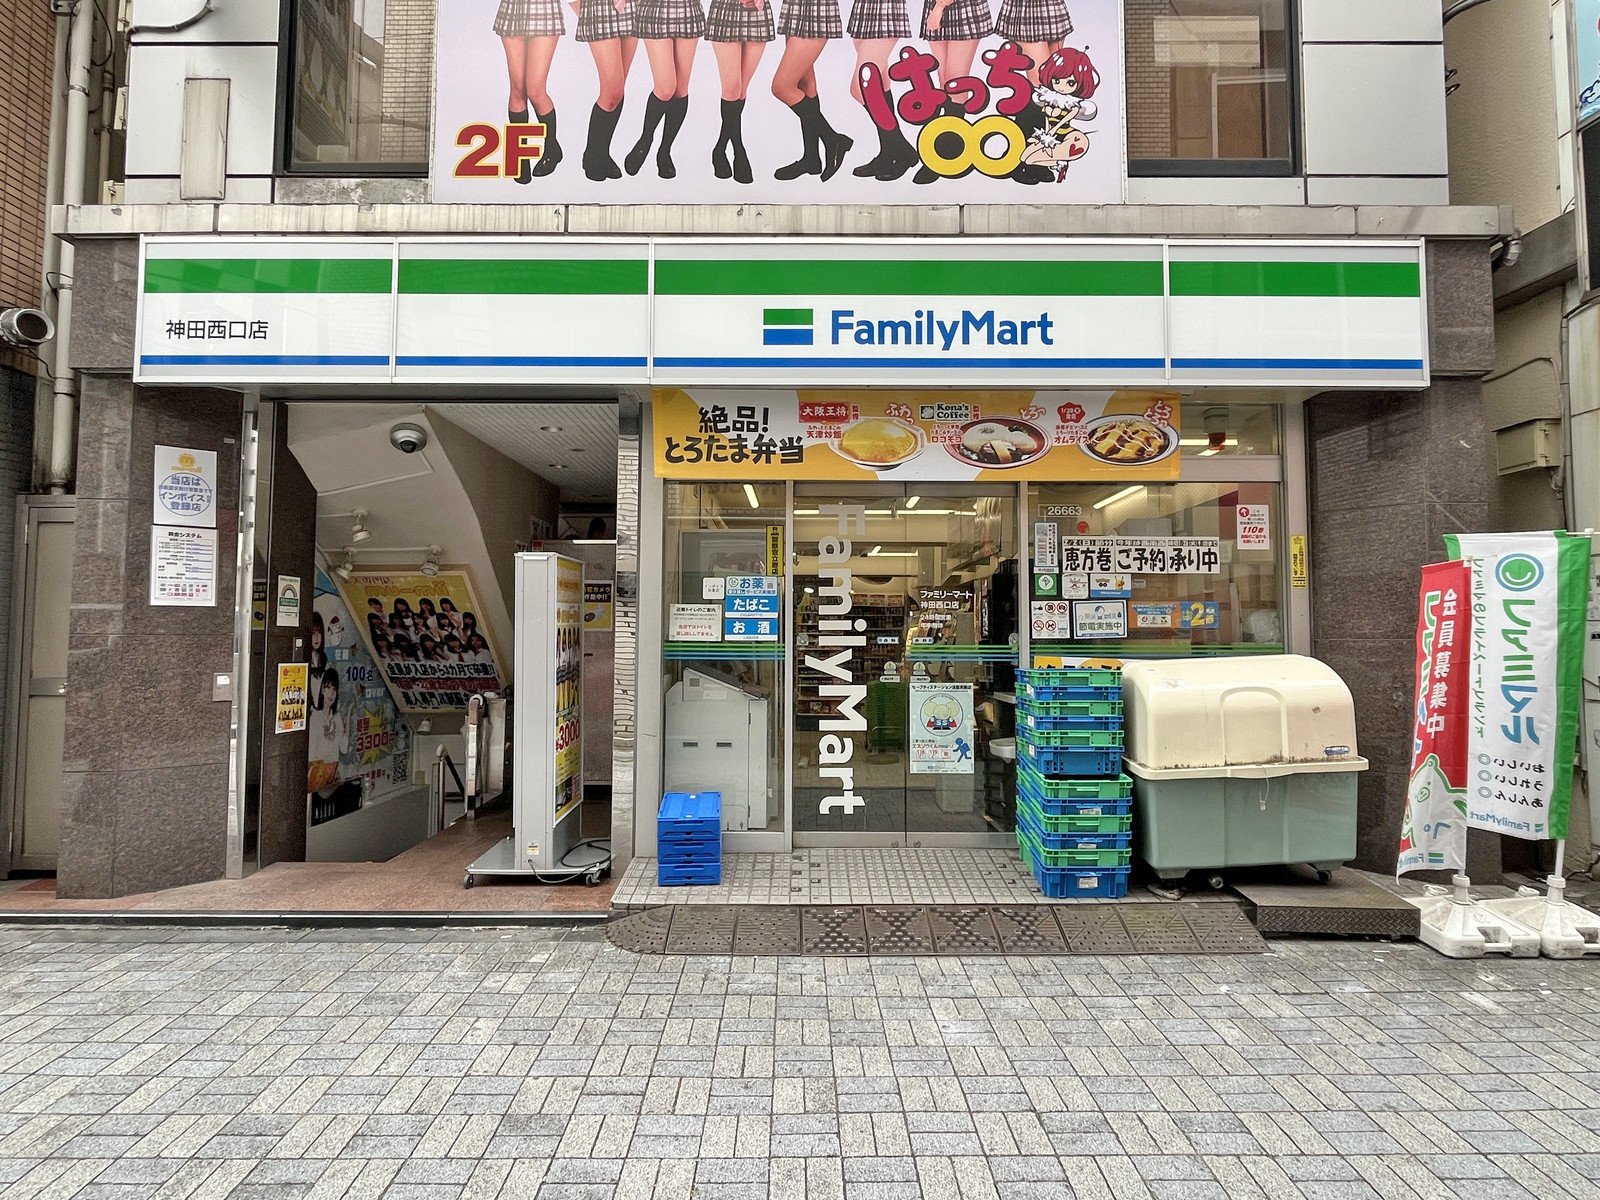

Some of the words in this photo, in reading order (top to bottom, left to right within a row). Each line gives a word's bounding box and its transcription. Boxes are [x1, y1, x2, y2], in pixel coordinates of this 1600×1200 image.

[453, 123, 547, 179] 2F
[165, 320, 269, 340] 神田西口店
[831, 309, 1053, 351] FamilyMart
[802, 406, 847, 417] 大阪王将
[936, 403, 970, 411] Kona's
[698, 404, 770, 433] 絶品!
[936, 411, 970, 419] Coffee
[806, 430, 842, 439] 天津炒飯
[932, 435, 962, 443] ロコモコ
[1054, 436, 1089, 444] オムライス
[665, 433, 804, 464] とろたま弁当
[171, 475, 202, 486] 当店は
[160, 492, 206, 503] インボイス
[1047, 506, 1082, 515] 26663
[739, 578, 764, 590] お薬
[920, 590, 973, 599] ファミリーマート
[733, 598, 770, 611] たばこ
[920, 601, 960, 609] 神田西口店
[732, 621, 770, 634] お酒
[1079, 622, 1122, 631] 節電実施中
[804, 504, 867, 815] FamilyMart
